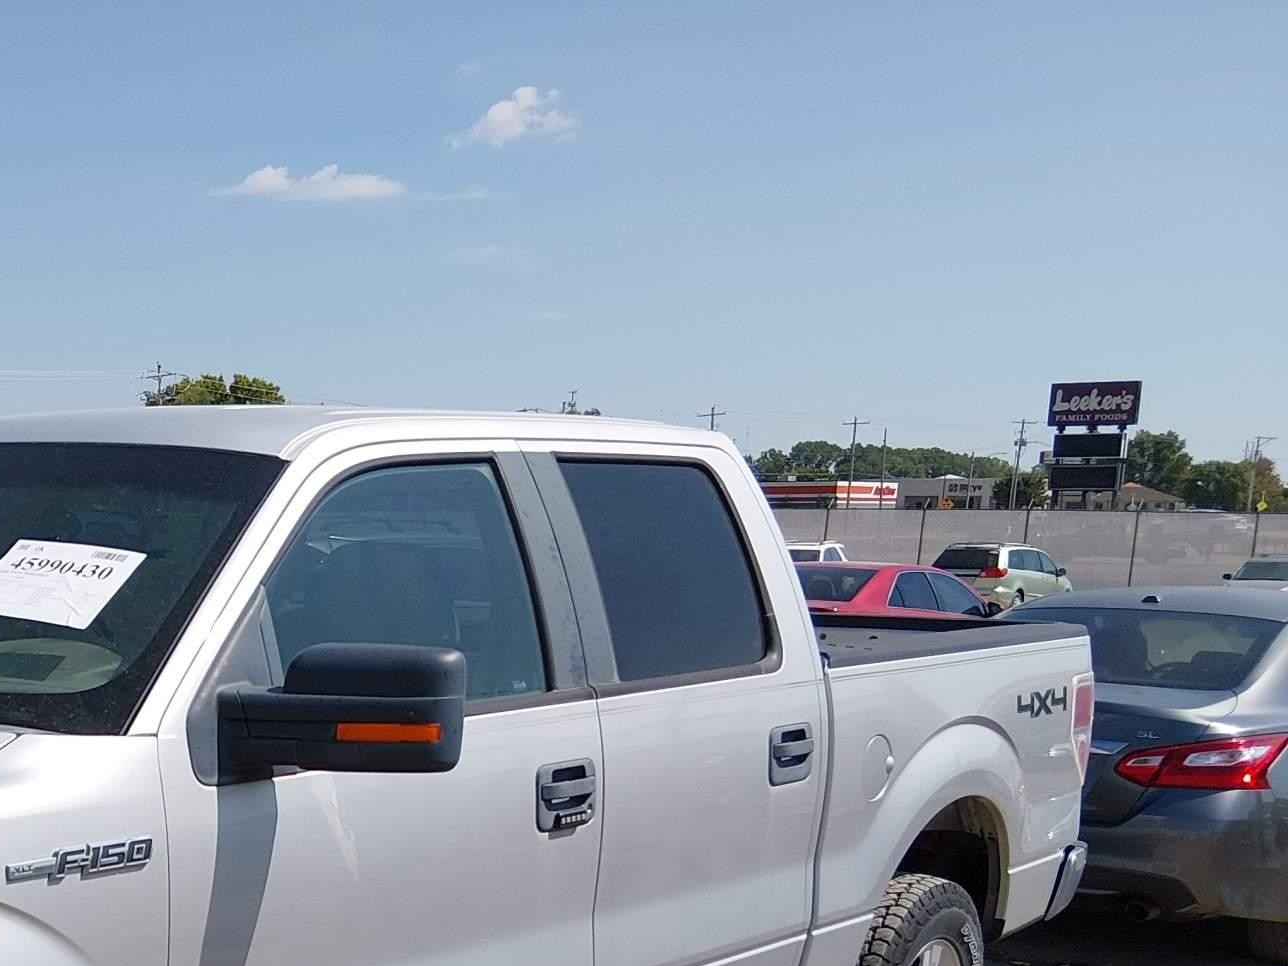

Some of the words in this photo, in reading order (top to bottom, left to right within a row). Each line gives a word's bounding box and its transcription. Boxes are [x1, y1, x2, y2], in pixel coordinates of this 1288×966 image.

[1053, 388, 1135, 412] Leeker's
[1055, 413, 1092, 422] FAMILY
[1094, 413, 1128, 421] FOODS
[10, 557, 114, 581] 45990430
[1135, 730, 1160, 739] SL
[14, 864, 33, 874] XLT
[55, 836, 153, 878] F-150
